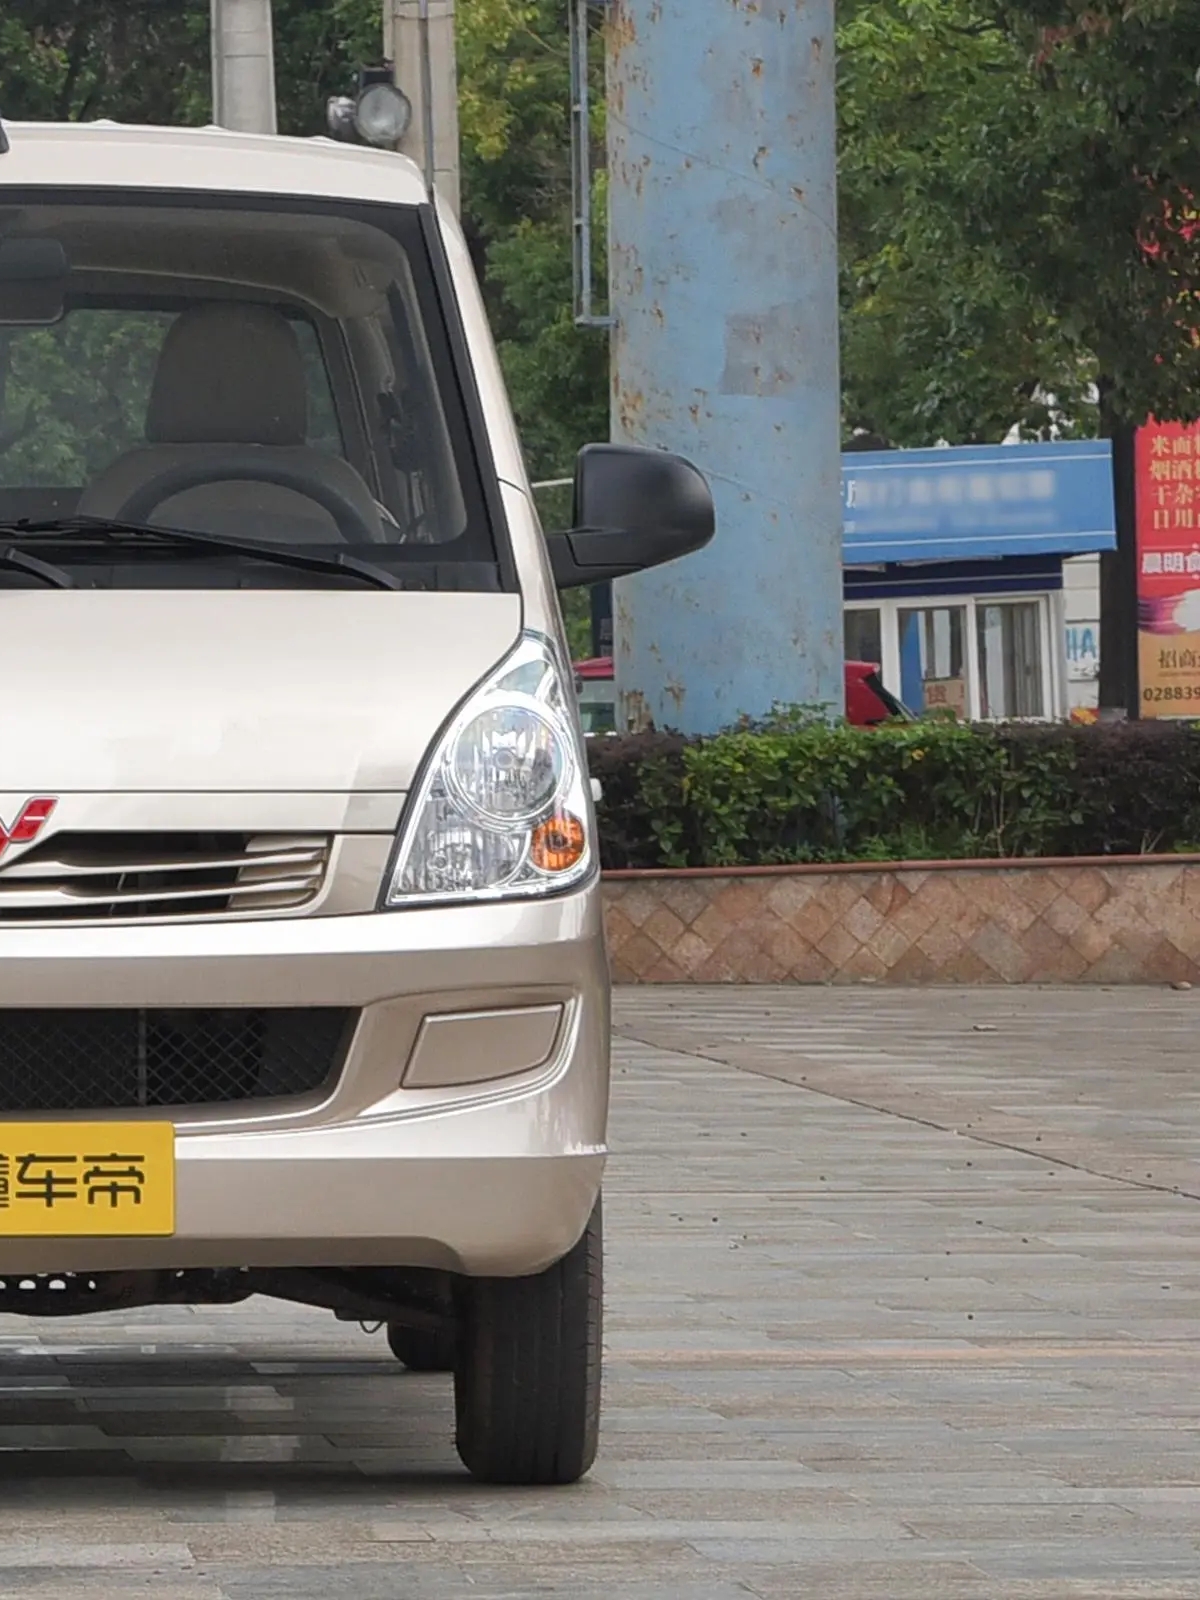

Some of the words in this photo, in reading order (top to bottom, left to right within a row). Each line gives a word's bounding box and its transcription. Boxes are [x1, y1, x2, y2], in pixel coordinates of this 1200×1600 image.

[1150, 435, 1200, 457] 米面
[1149, 459, 1200, 481] 烟酒
[1151, 482, 1200, 506] 干杂
[1158, 648, 1200, 669] 招商
